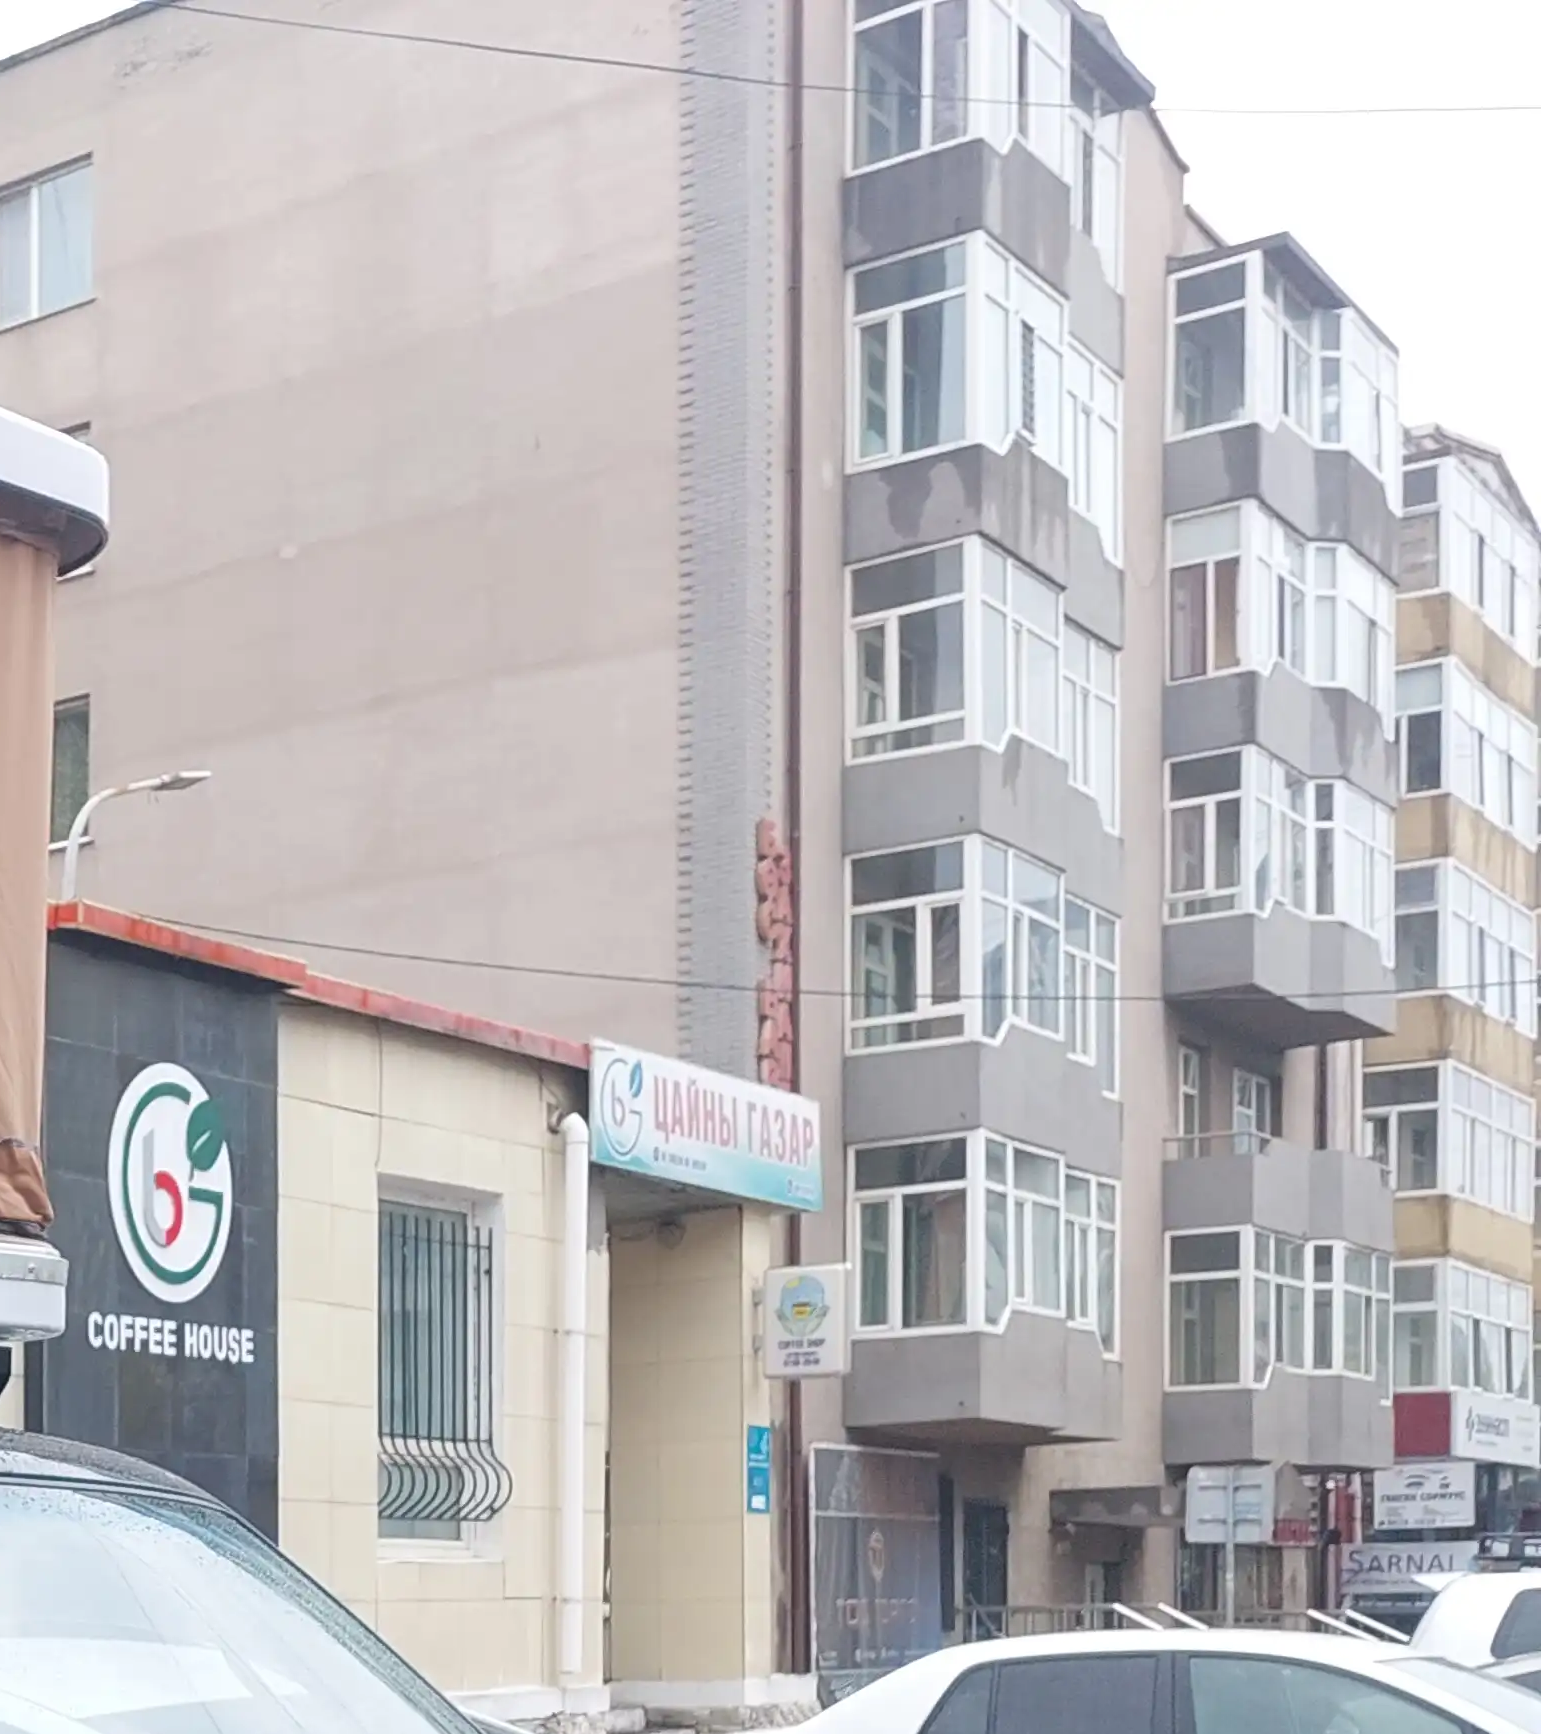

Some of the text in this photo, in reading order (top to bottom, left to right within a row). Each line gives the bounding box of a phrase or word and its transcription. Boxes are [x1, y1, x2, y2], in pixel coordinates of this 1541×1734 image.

[654, 1075, 815, 1168] ЦАЙНЫ ГАЗАР
[87, 1311, 255, 1364] COFFEE HOUSE
[1348, 1549, 1454, 1573] SARNAI
